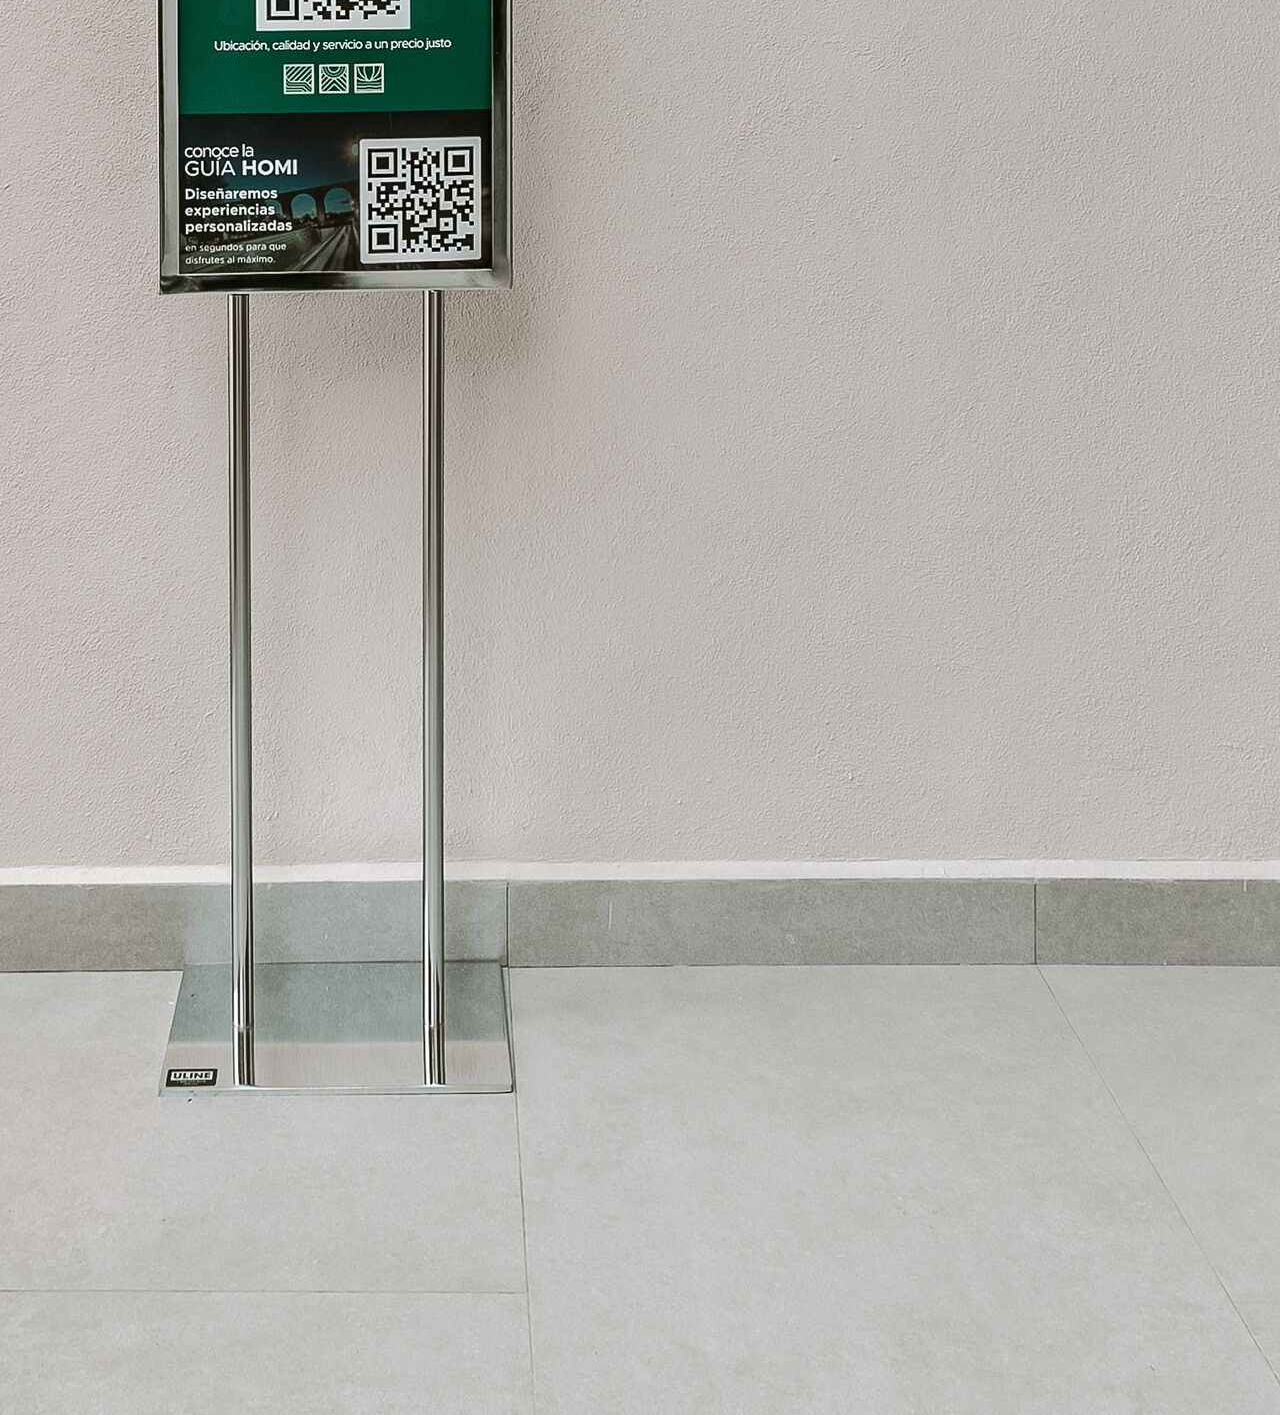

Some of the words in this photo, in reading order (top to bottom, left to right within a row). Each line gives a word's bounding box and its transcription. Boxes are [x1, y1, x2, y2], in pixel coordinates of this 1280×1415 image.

[214, 40, 270, 52] Ubicación,
[272, 40, 310, 50] calidad
[312, 42, 321, 52] y
[322, 39, 363, 50] servicio
[365, 41, 372, 49] a
[374, 41, 388, 49] un
[390, 38, 424, 51] precio
[424, 38, 452, 50] justo
[184, 146, 239, 158] conoce
[242, 144, 254, 157] la
[185, 157, 236, 176] GUÍA
[242, 159, 298, 176] HOMI
[185, 187, 278, 200] Diseñaremos
[185, 203, 275, 218] experiencias
[185, 219, 293, 235] personalizadas
[199, 243, 244, 253] segundos
[246, 244, 267, 252] para
[269, 243, 287, 252] que
[185, 256, 225, 264] disfrutes
[227, 256, 235, 264] al
[237, 255, 276, 263] máximo.
